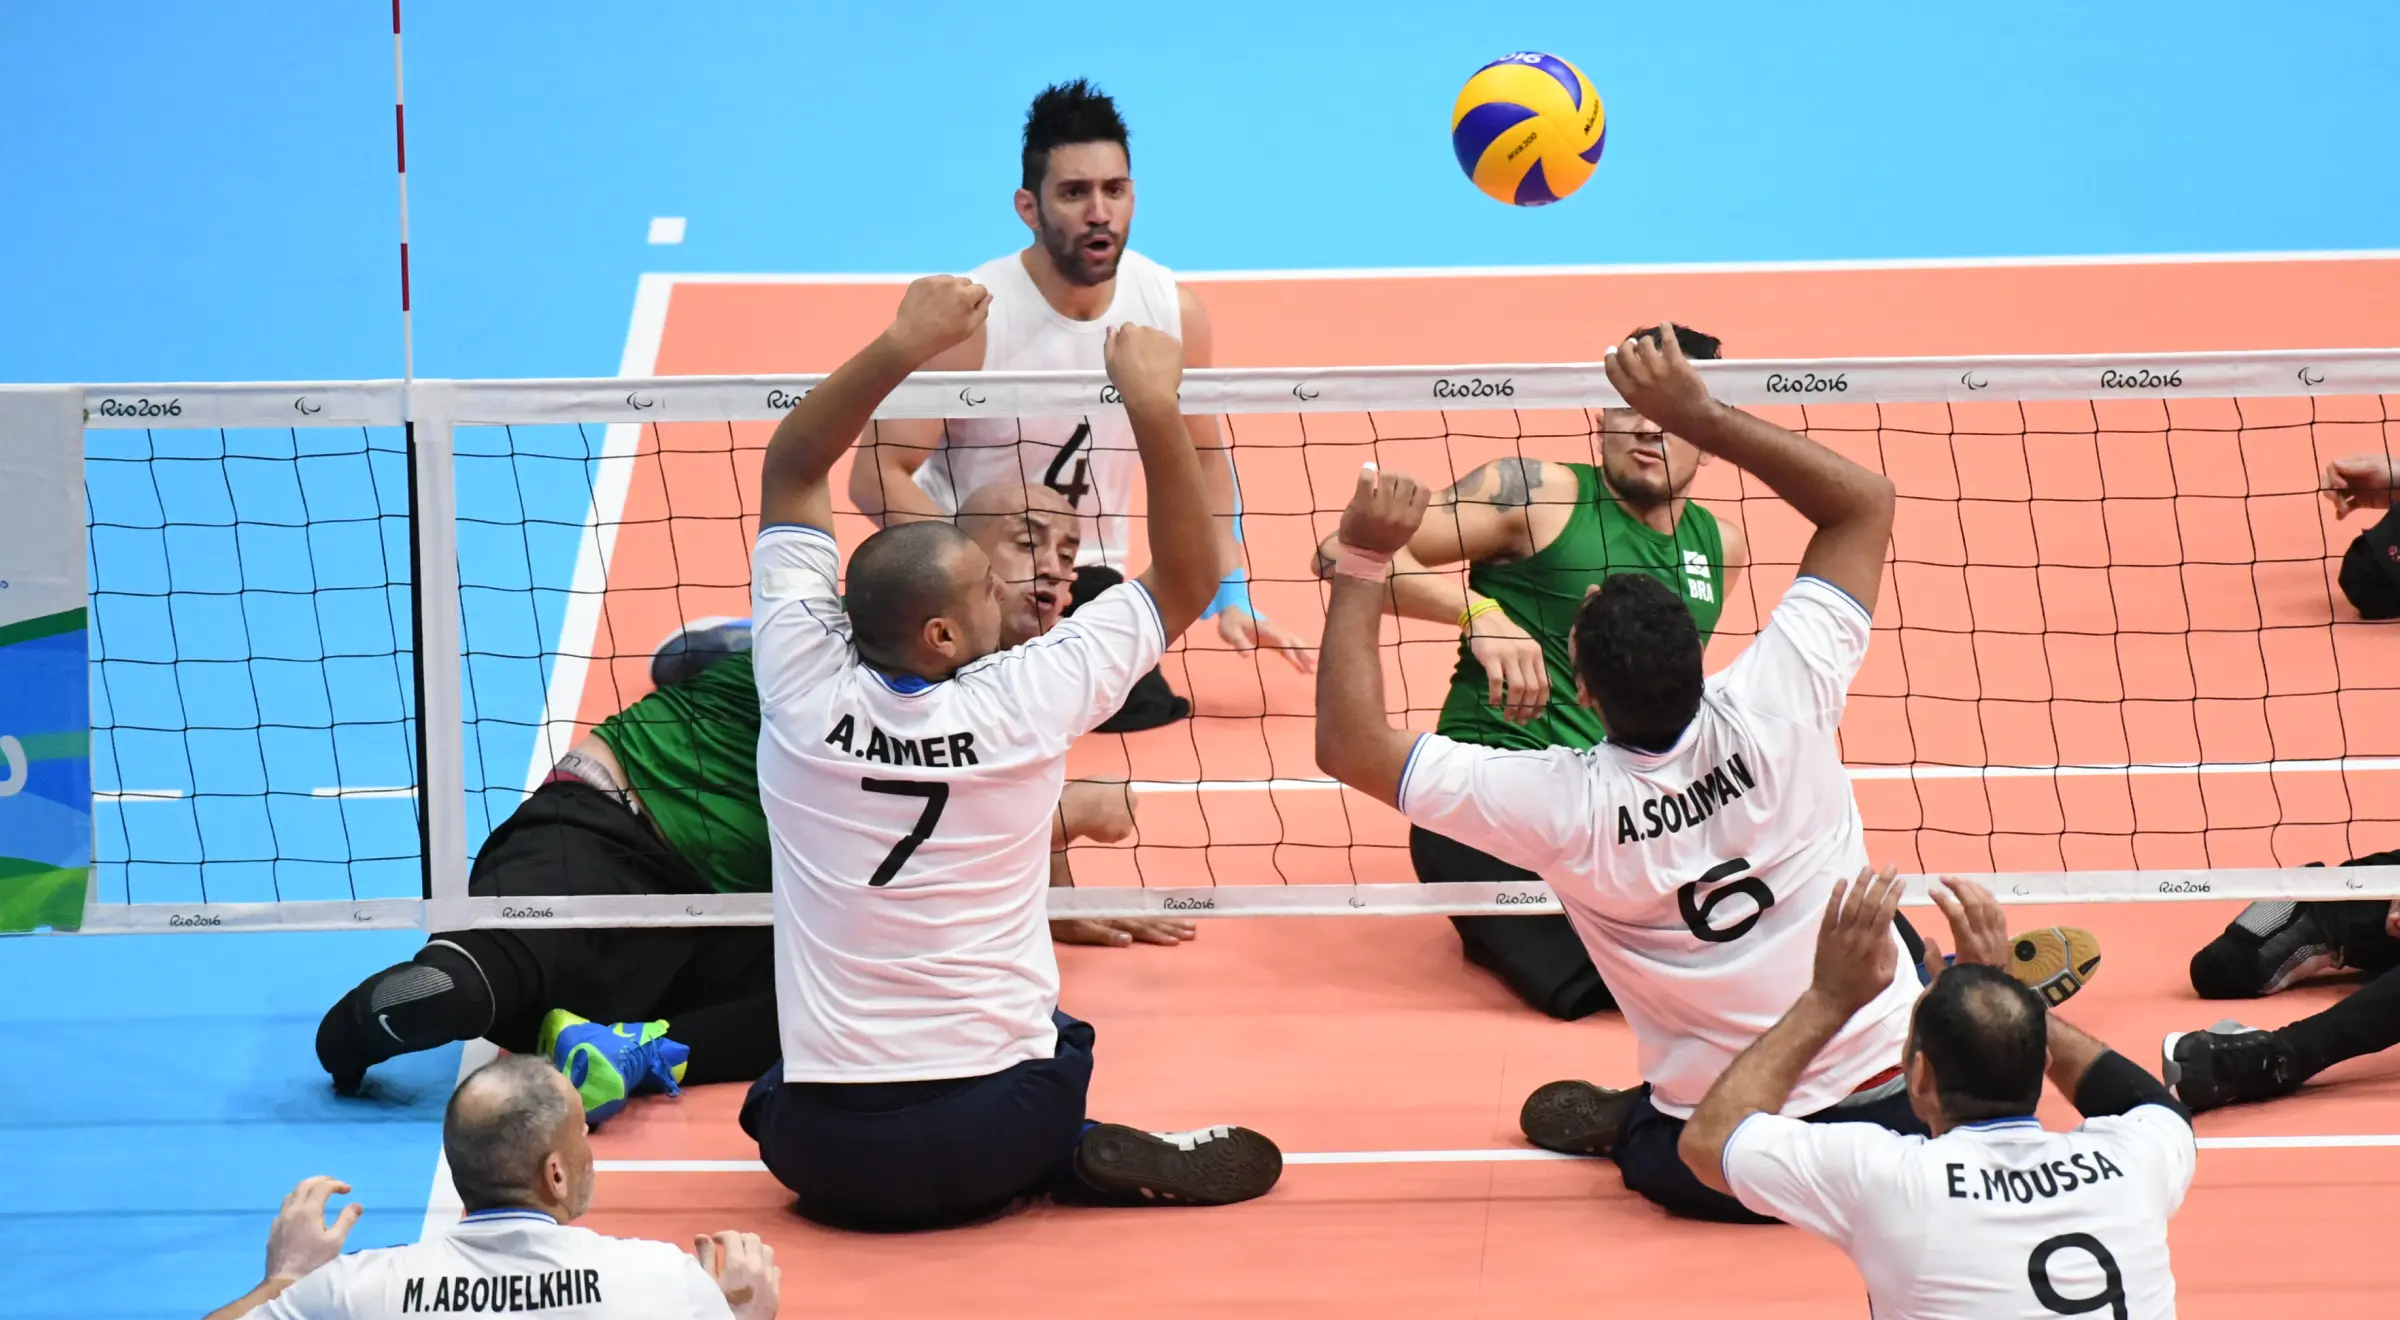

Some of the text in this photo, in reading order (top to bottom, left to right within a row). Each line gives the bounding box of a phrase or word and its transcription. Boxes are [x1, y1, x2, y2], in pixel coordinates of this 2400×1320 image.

[1433, 378, 1515, 398] Rio2016
[1766, 373, 1848, 393] Rio2016
[2100, 369, 2183, 388] Rio2016
[100, 398, 182, 417] Rio2016
[1044, 423, 1090, 510] 4
[1687, 578, 1714, 604] BRA
[825, 713, 979, 767] A.AMER
[1618, 752, 1756, 845] A.SOLIMAN
[861, 776, 949, 886] 7
[1495, 891, 1547, 905] Rio2016
[2159, 880, 2211, 893] Rio2016
[1163, 897, 1215, 910] Rio2016
[1677, 857, 1775, 942] 6
[169, 914, 222, 926] Rio2016
[502, 907, 553, 918] Rio2016
[1946, 1150, 2124, 1204] E.MOUSSA
[2027, 1232, 2128, 1320] 9
[402, 1269, 602, 1314] M.ABOUELKHIR
